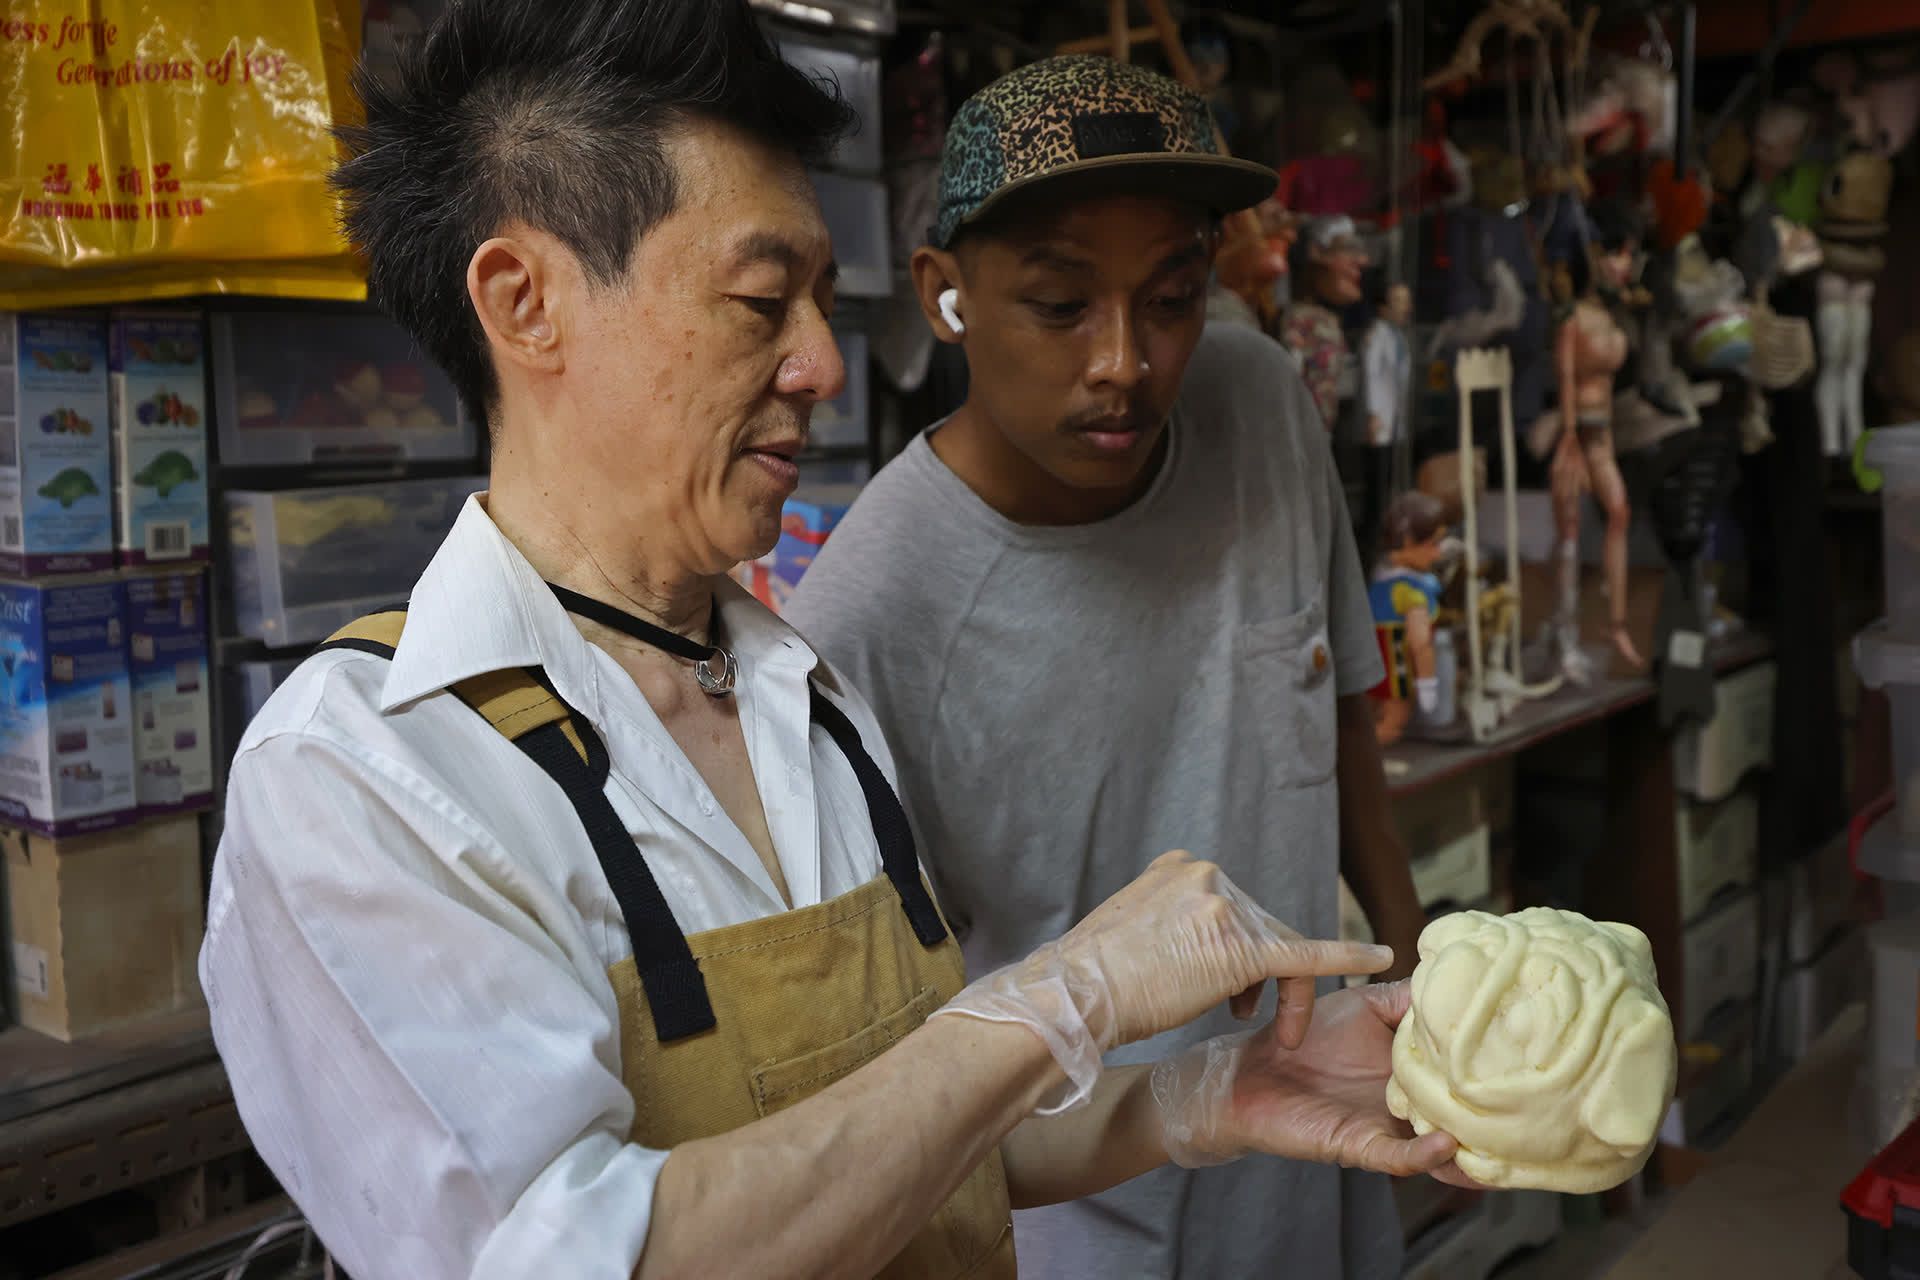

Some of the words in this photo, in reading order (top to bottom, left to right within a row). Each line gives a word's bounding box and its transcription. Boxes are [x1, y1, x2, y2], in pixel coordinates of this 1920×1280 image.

[57, 57, 193, 87] Genrations
[205, 50, 236, 85] of
[240, 50, 286, 84] joy
